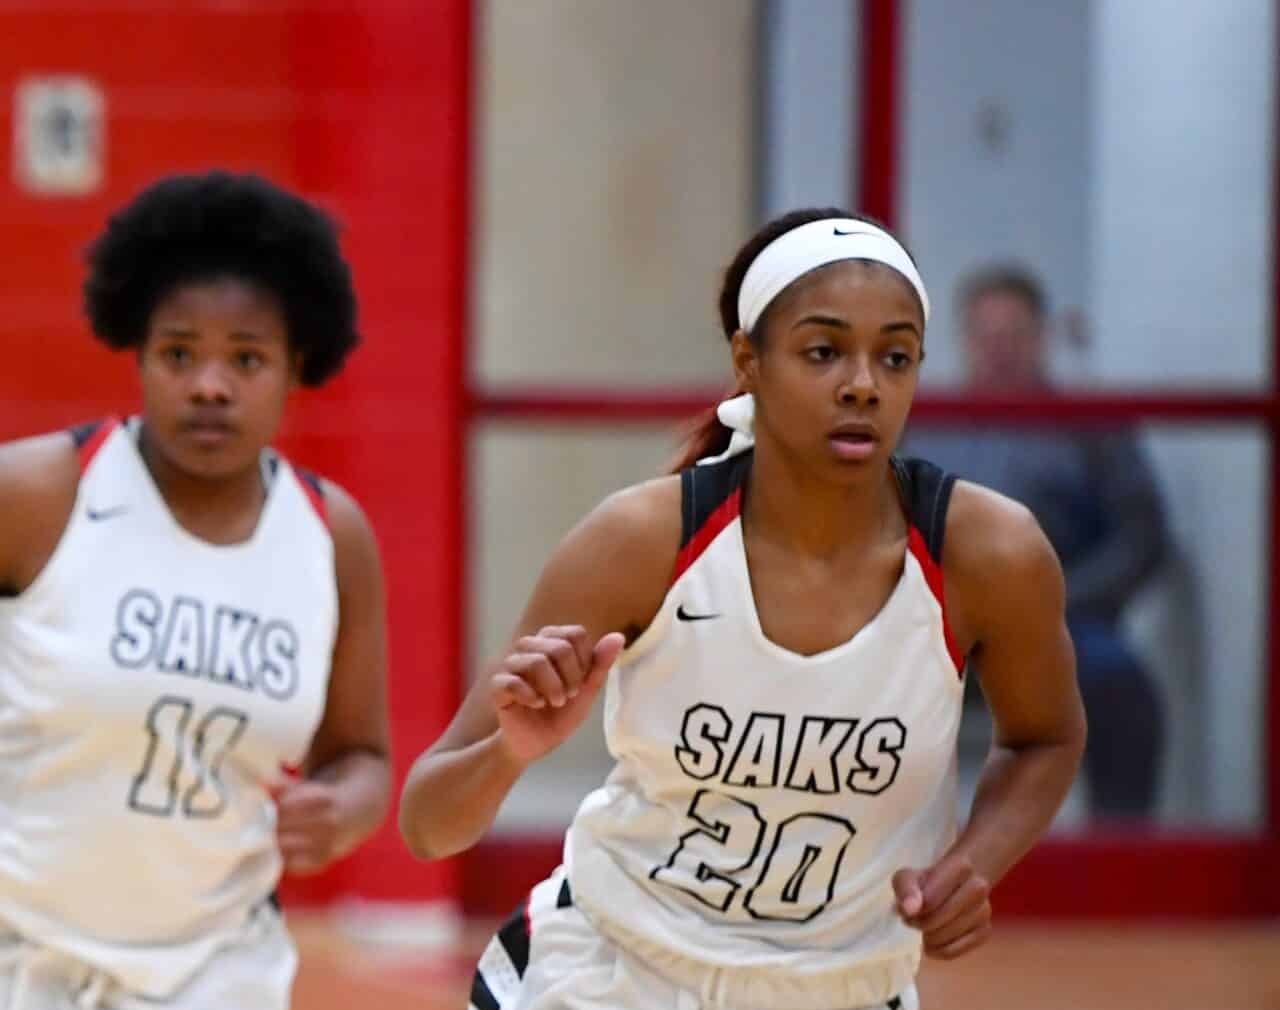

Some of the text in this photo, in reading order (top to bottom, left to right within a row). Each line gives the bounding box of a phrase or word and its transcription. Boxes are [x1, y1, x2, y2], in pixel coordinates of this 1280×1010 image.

[109, 588, 300, 701] SAKS
[674, 702, 907, 796] SAKS
[649, 788, 856, 923] 20
